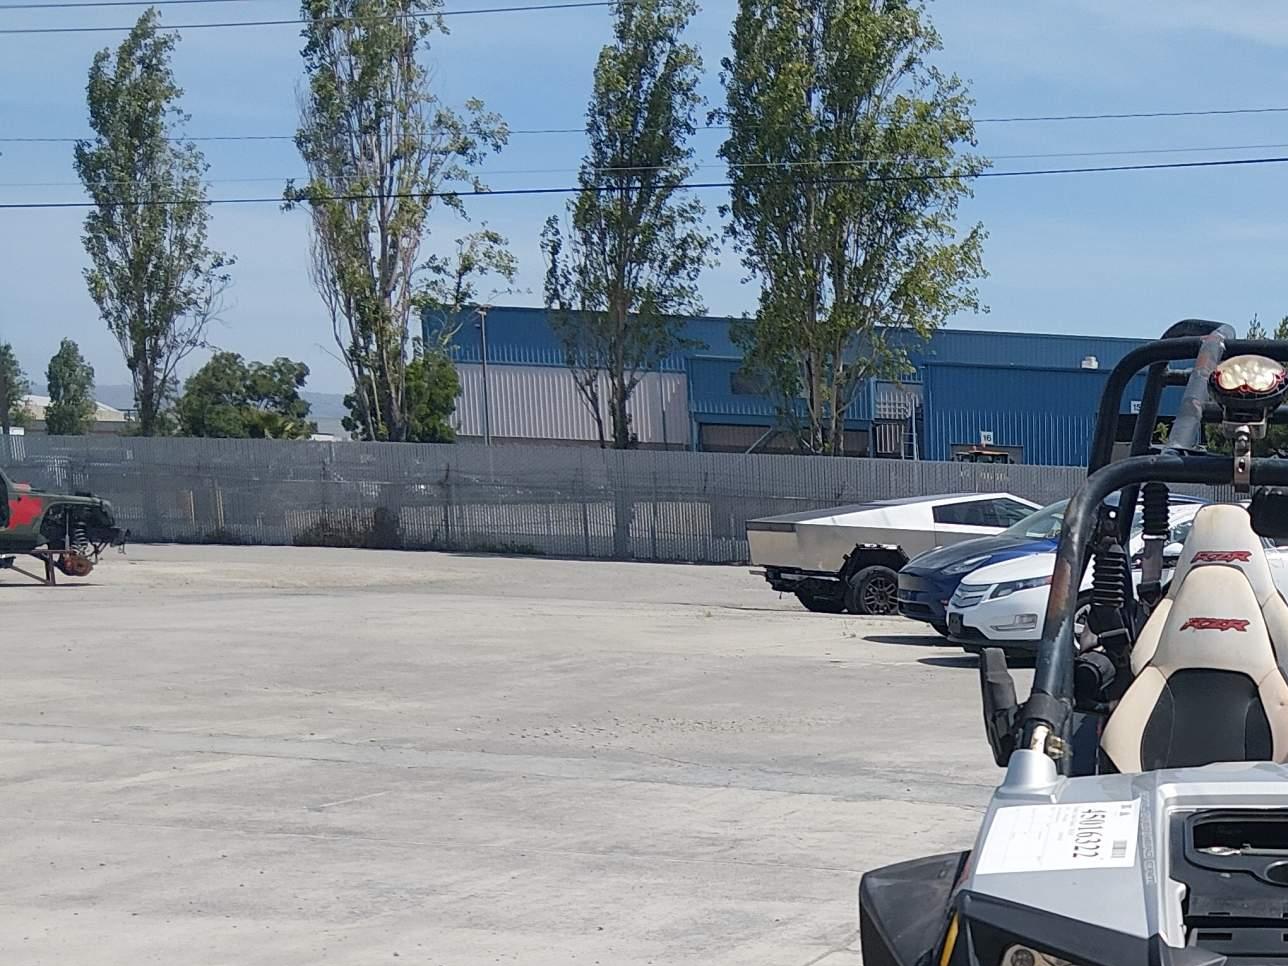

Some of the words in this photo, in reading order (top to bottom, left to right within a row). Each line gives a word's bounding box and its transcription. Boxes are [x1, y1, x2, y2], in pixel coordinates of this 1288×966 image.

[983, 434, 992, 442] 16
[1190, 550, 1252, 564] RZR
[1180, 617, 1251, 632] RZR
[1072, 808, 1107, 859] 45016322
